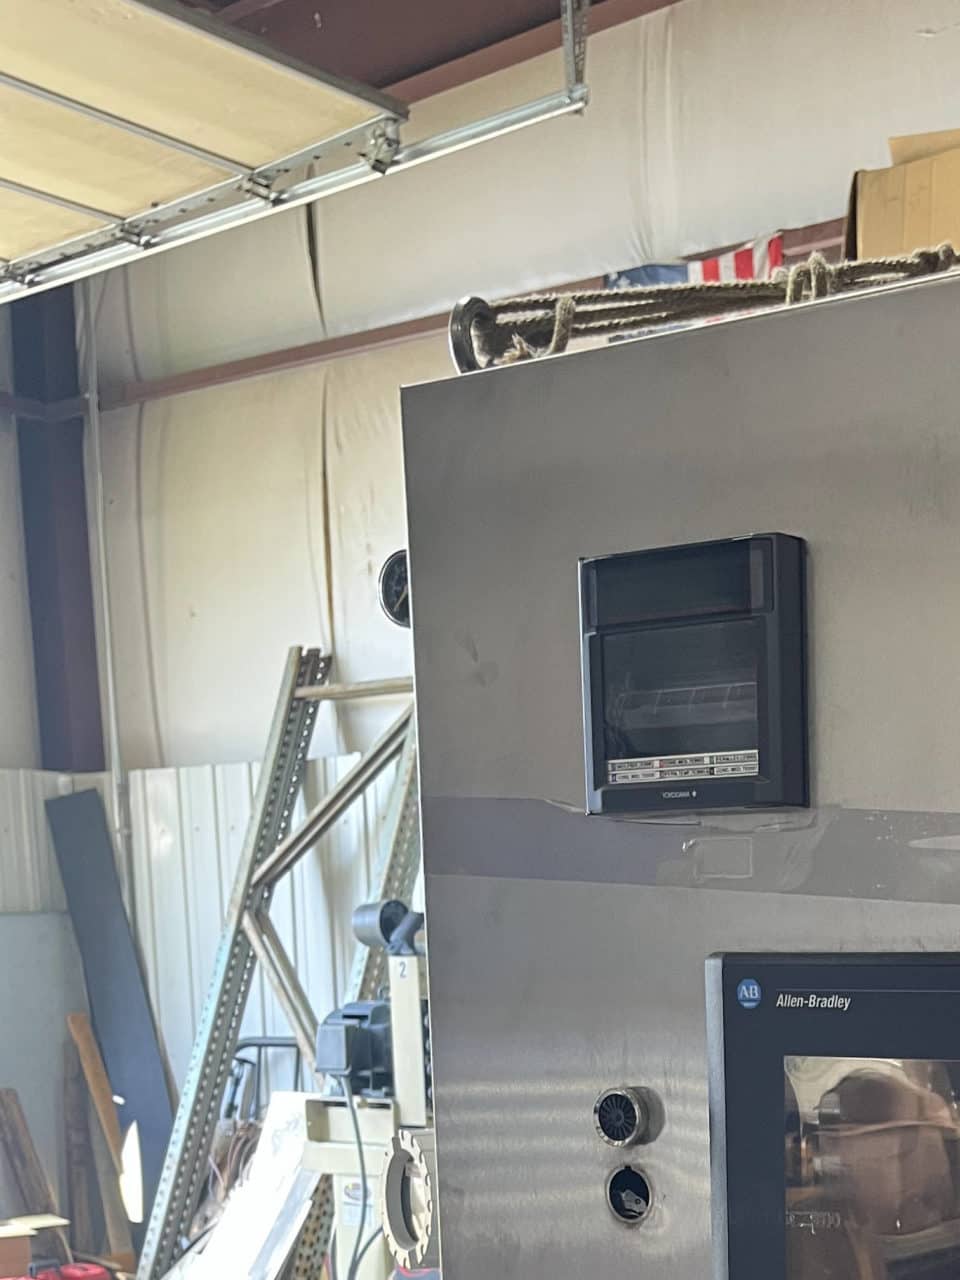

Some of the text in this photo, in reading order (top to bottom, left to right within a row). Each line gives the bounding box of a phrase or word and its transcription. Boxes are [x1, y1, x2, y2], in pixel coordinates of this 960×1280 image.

[400, 961, 407, 978] 2
[740, 984, 759, 999] AB
[776, 993, 851, 1011] Allen-Bradley
